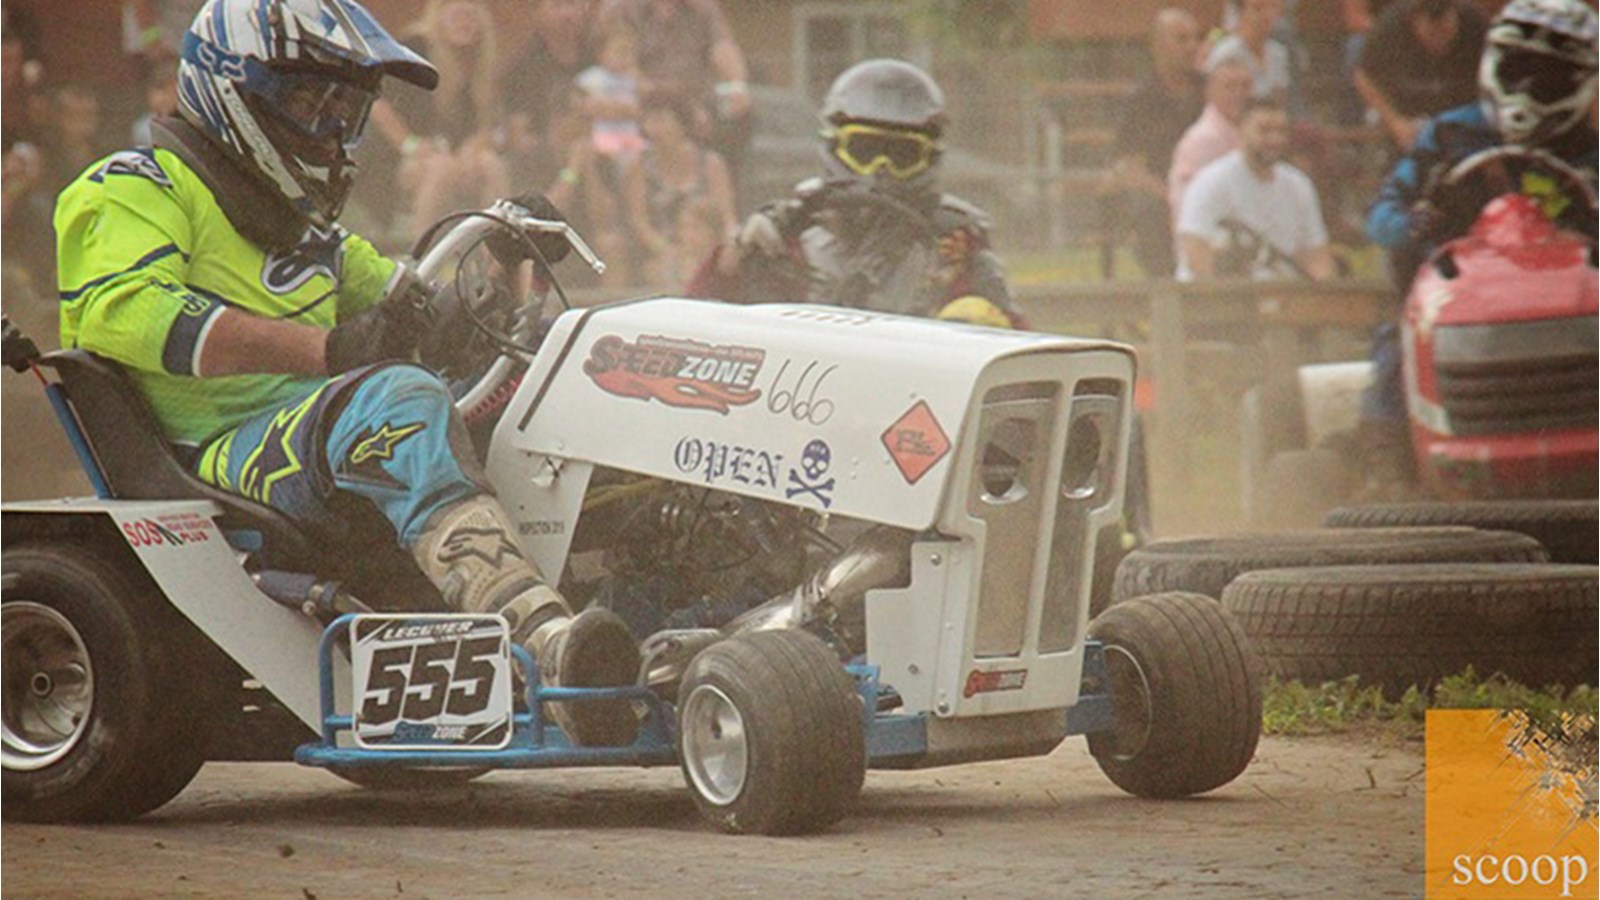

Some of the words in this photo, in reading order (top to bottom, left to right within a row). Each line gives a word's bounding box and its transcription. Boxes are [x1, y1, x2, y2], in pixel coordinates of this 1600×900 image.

[678, 355, 758, 387] ZONE
[767, 358, 839, 427] 666
[674, 434, 784, 489] OPEN
[122, 521, 163, 548] SOS
[361, 637, 502, 726] 555
